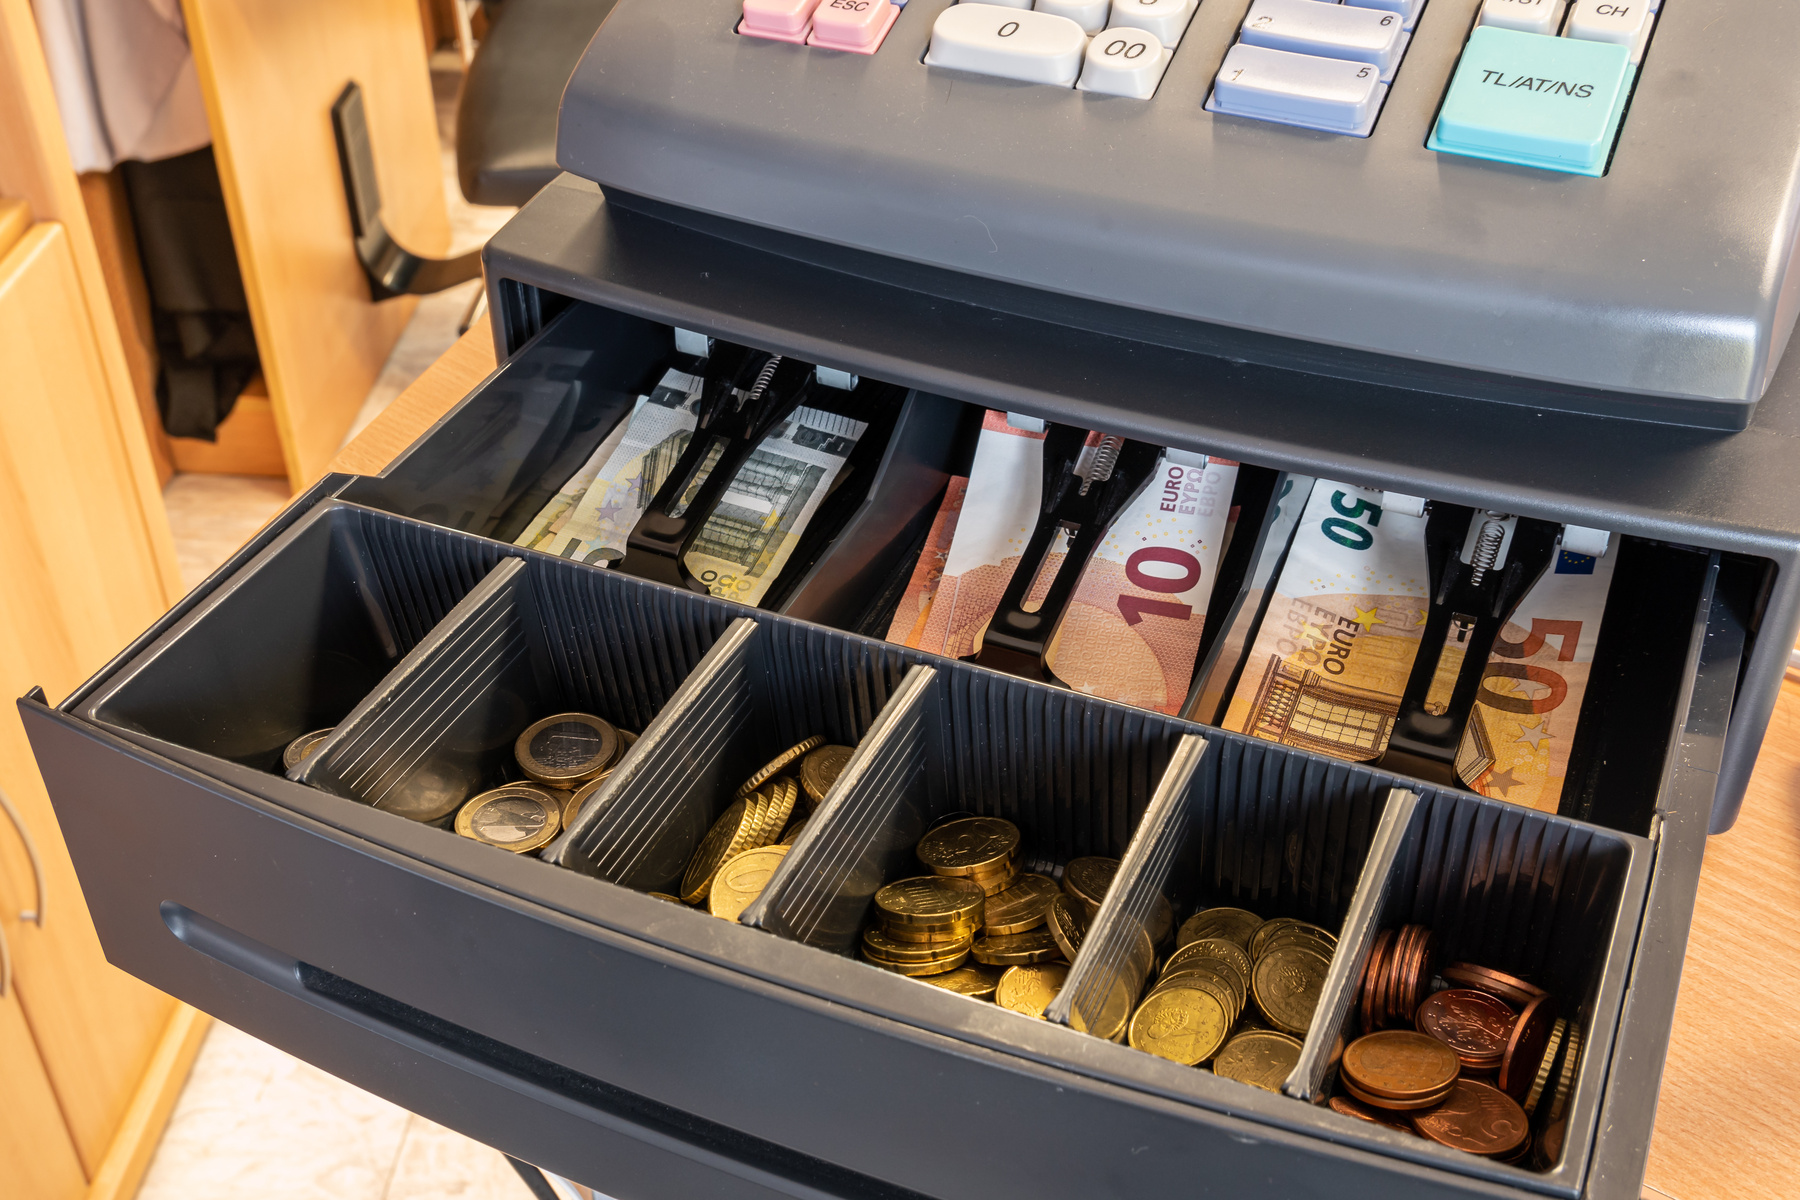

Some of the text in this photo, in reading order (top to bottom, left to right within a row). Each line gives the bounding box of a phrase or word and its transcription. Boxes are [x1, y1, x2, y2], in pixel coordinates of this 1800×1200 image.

[830, 0, 869, 11] ESC
[1596, 5, 1630, 17] CH
[1253, 16, 1273, 29] 2
[1380, 16, 1394, 26] 6
[997, 22, 1020, 37] 0
[1104, 40, 1146, 58] 00
[1230, 68, 1245, 81] 1
[1356, 67, 1372, 78] 5
[1482, 69, 1595, 98] TL/AT/NS
[1159, 466, 1184, 513] EURO
[1321, 489, 1383, 551] 50
[1116, 546, 1202, 627] 10
[1323, 616, 1360, 676] EURO
[1476, 617, 1584, 715] 50
